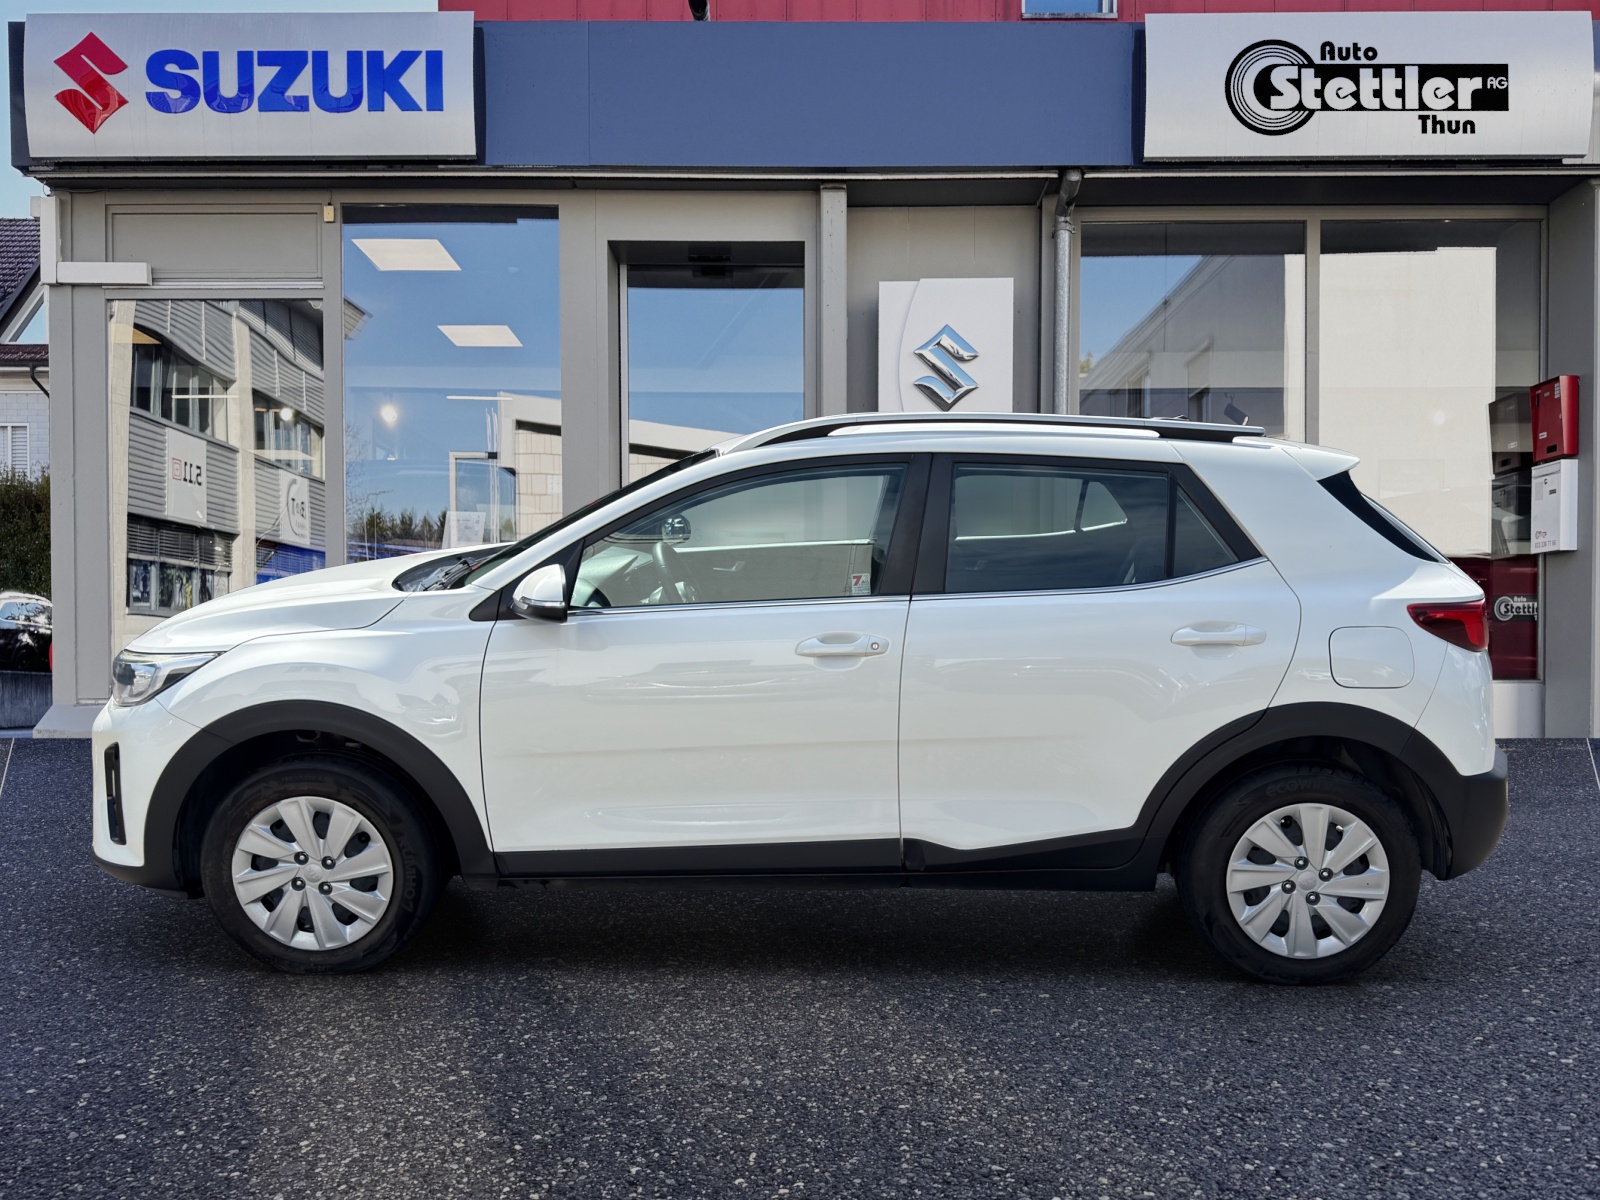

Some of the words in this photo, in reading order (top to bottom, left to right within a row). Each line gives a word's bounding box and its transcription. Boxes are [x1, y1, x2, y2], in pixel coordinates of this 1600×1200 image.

[1320, 41, 1378, 61] Auto
[145, 49, 443, 114] SUZUKI
[1270, 66, 1482, 110] Stettler
[1487, 76, 1508, 90] AG
[1418, 115, 1476, 134] Thun
